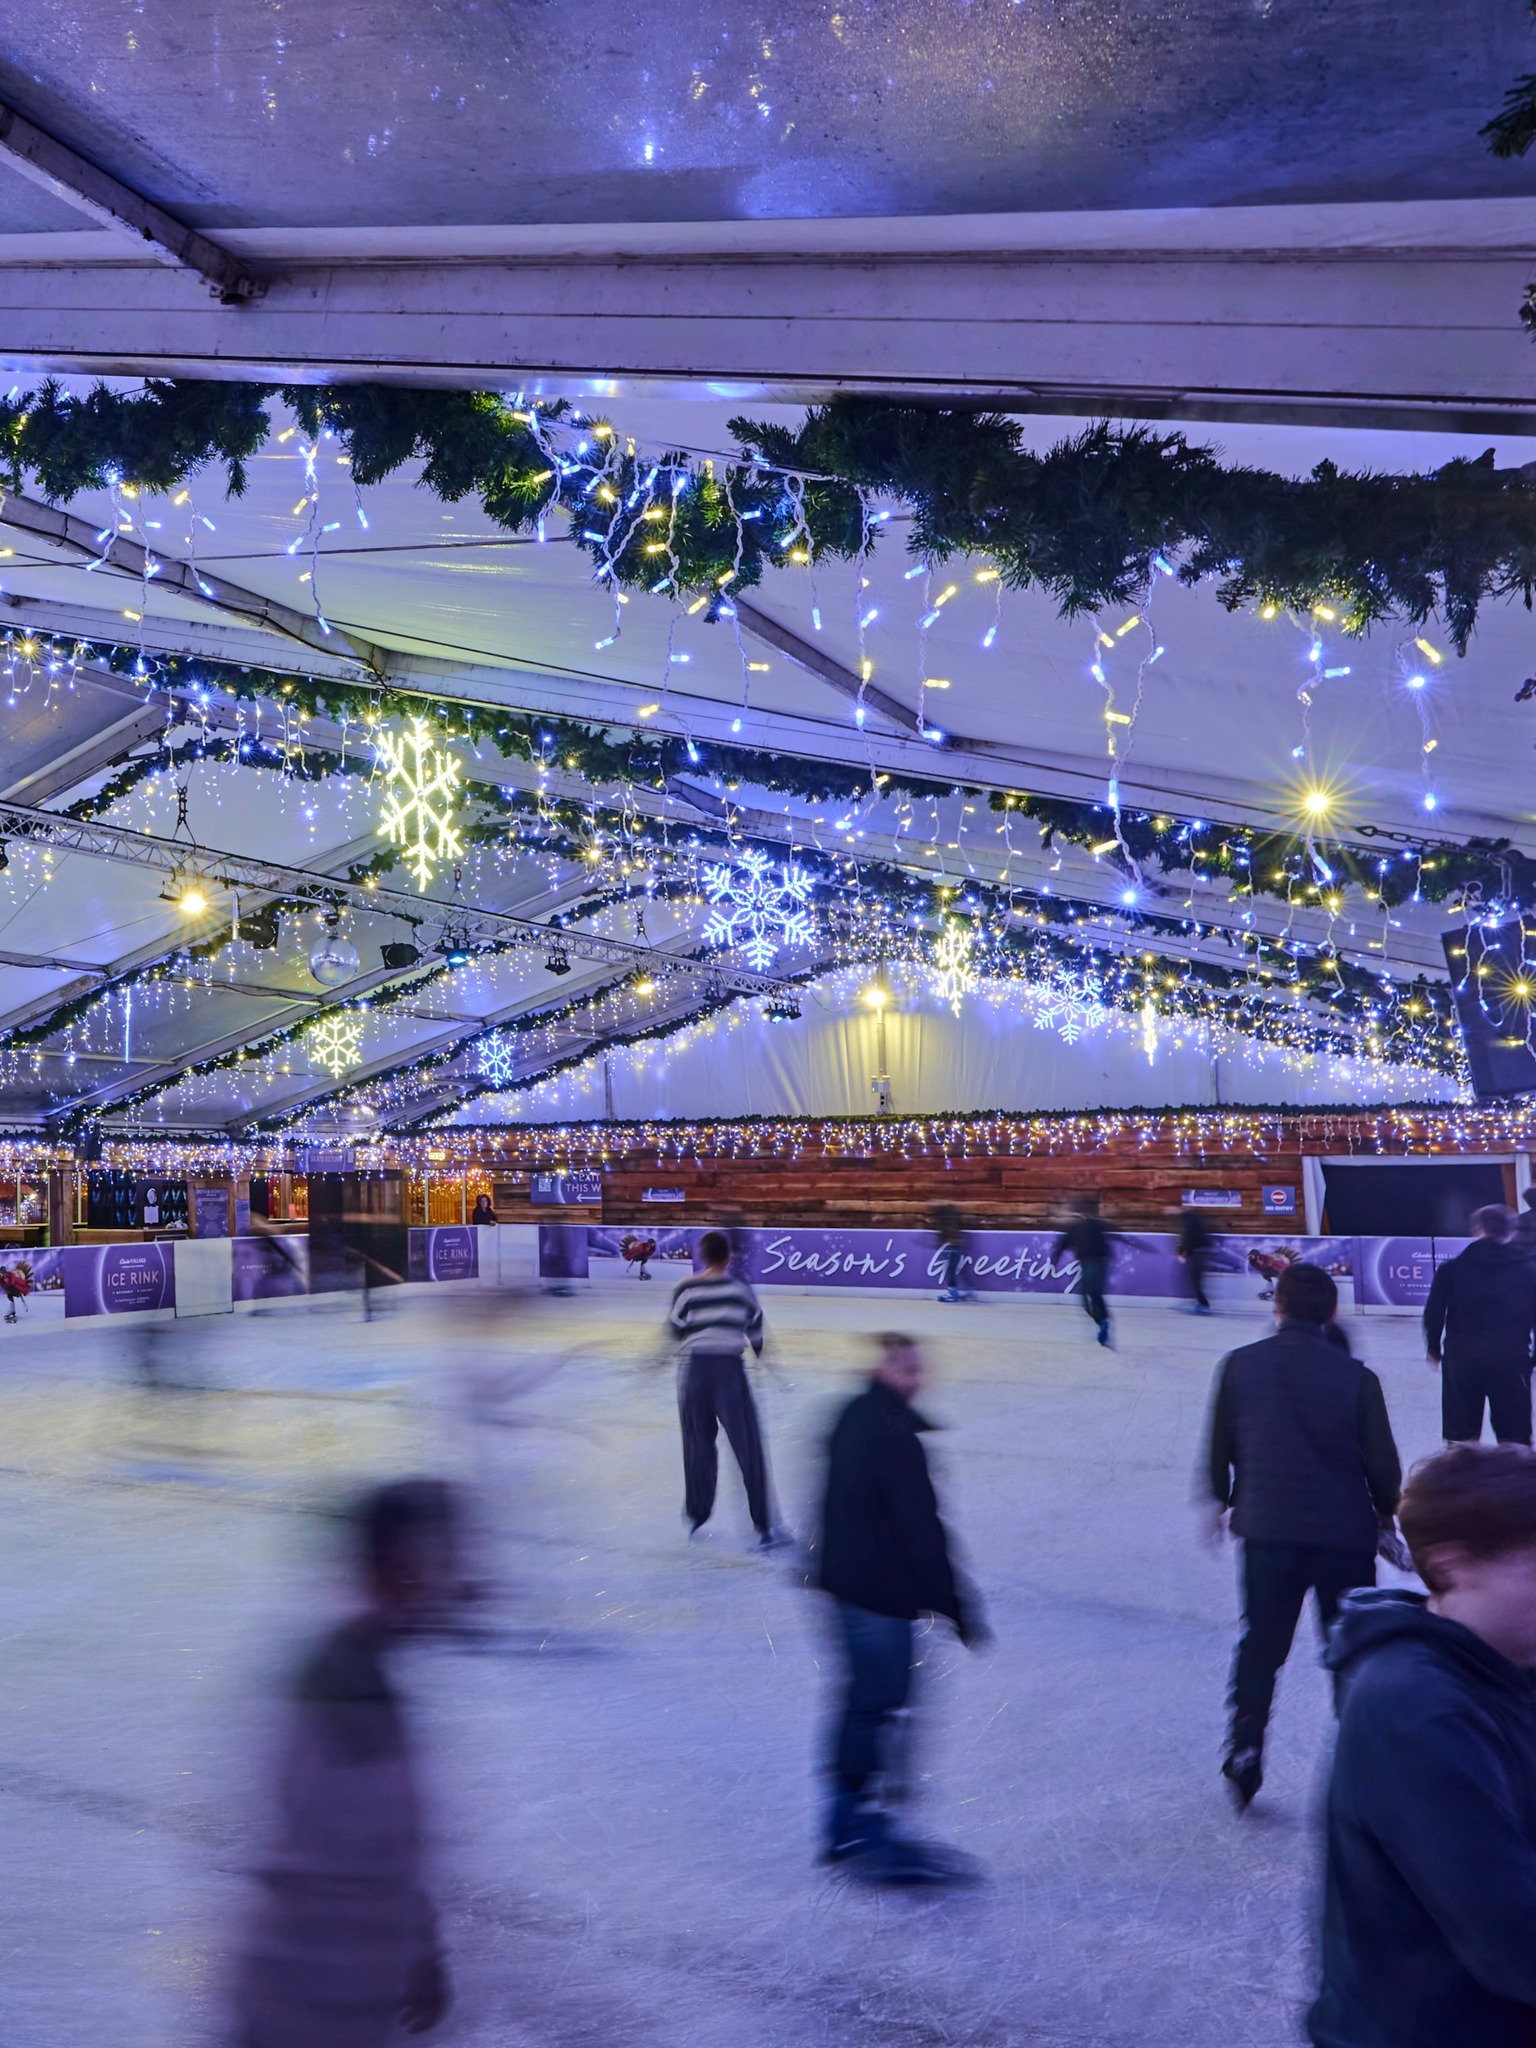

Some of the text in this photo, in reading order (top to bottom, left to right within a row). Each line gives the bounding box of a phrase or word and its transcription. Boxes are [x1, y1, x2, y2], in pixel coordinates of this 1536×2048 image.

[578, 1172, 601, 1182] EXIT
[565, 1183, 589, 1192] THIS
[435, 1248, 469, 1260] ICE RINK
[761, 1236, 1083, 1295] Season's Greeting
[1389, 1265, 1423, 1279] ICE
[107, 1270, 159, 1287] ICE RINK
